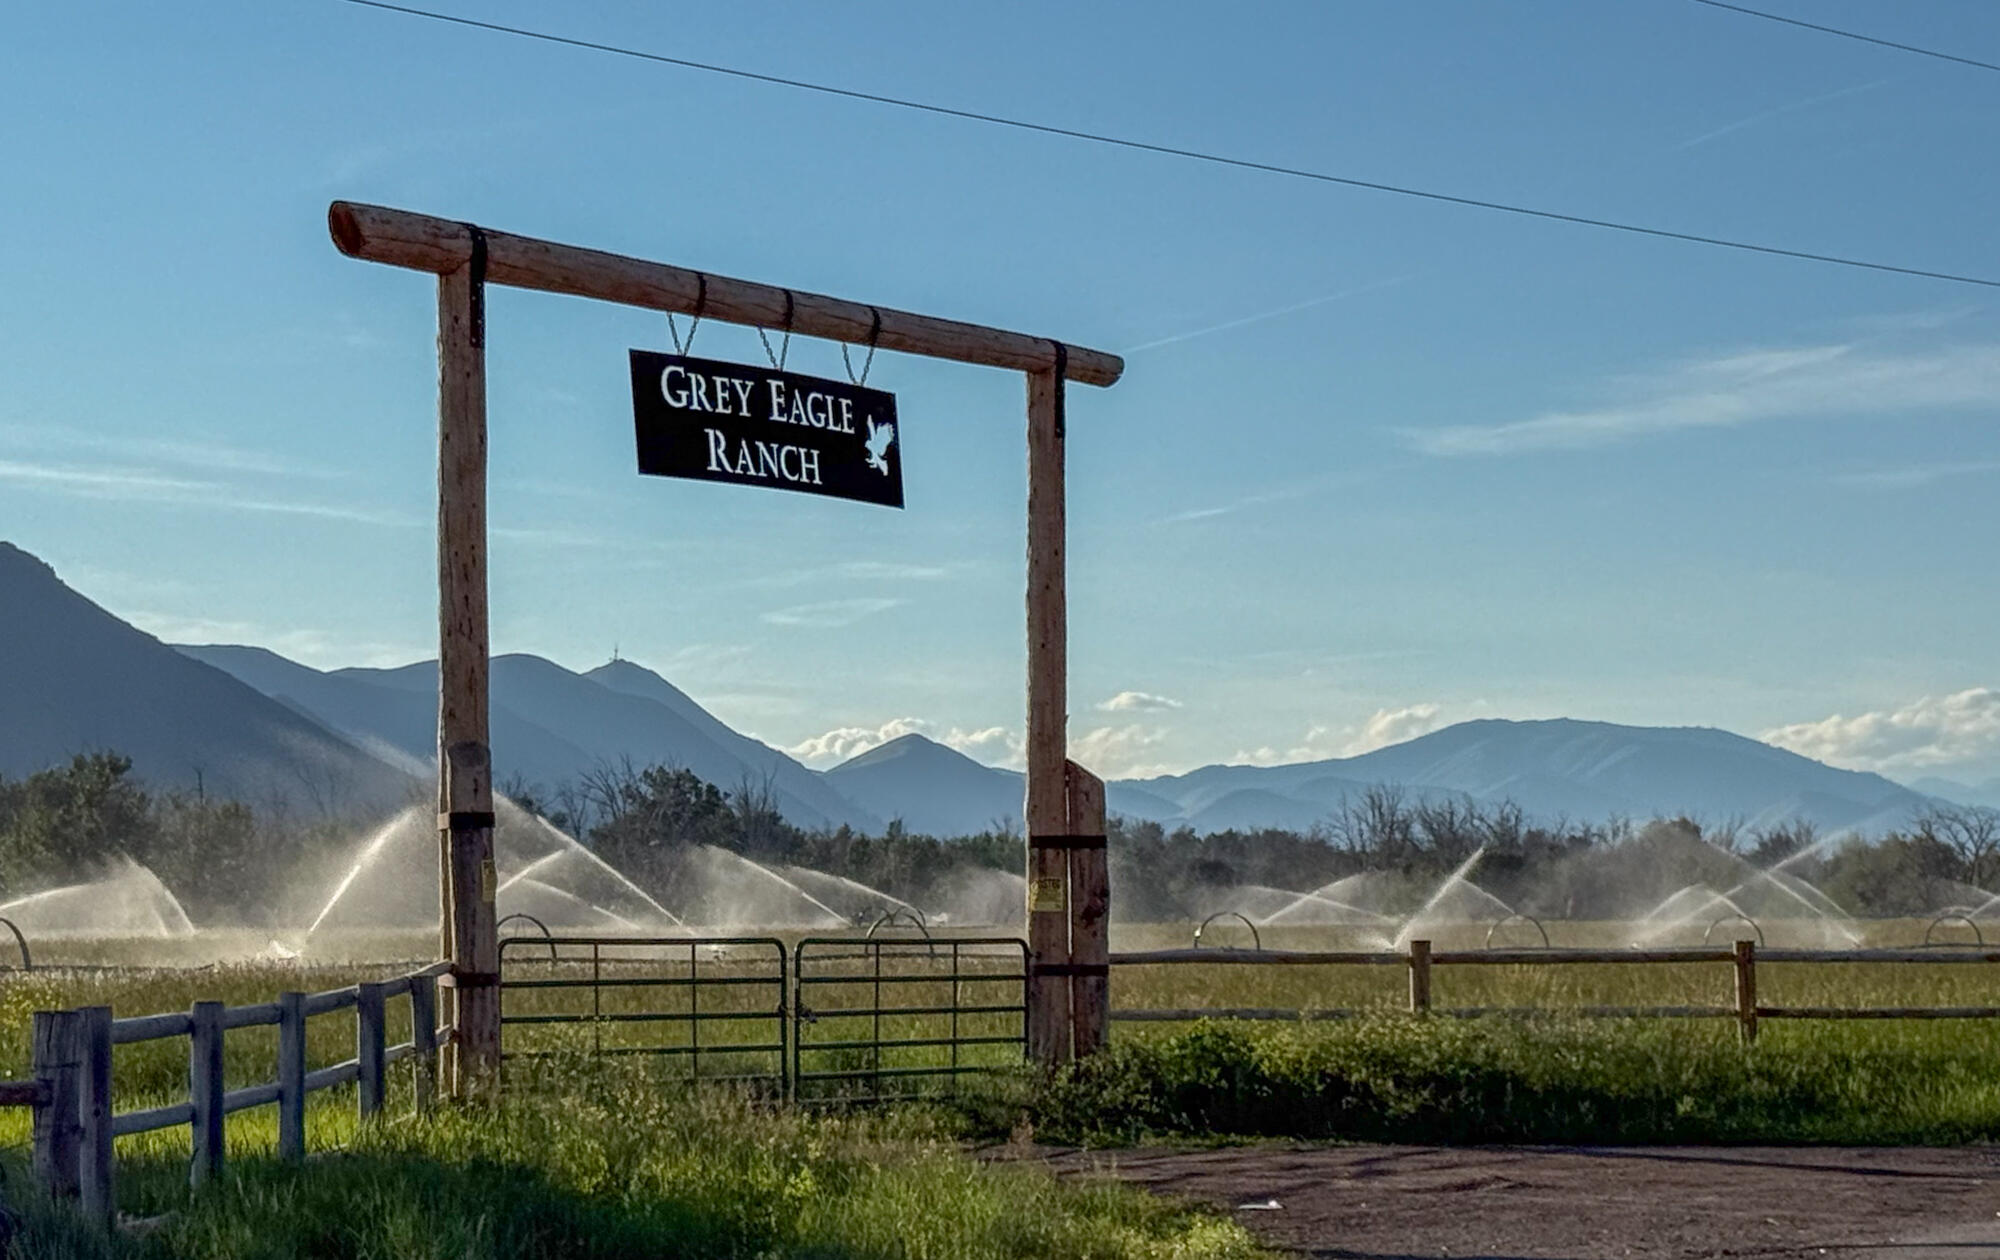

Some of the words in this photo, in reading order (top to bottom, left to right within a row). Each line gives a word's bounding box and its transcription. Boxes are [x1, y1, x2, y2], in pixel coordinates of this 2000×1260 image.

[661, 365, 754, 417] GREY
[767, 379, 855, 434] EAGLE
[704, 428, 822, 484] RANCH
